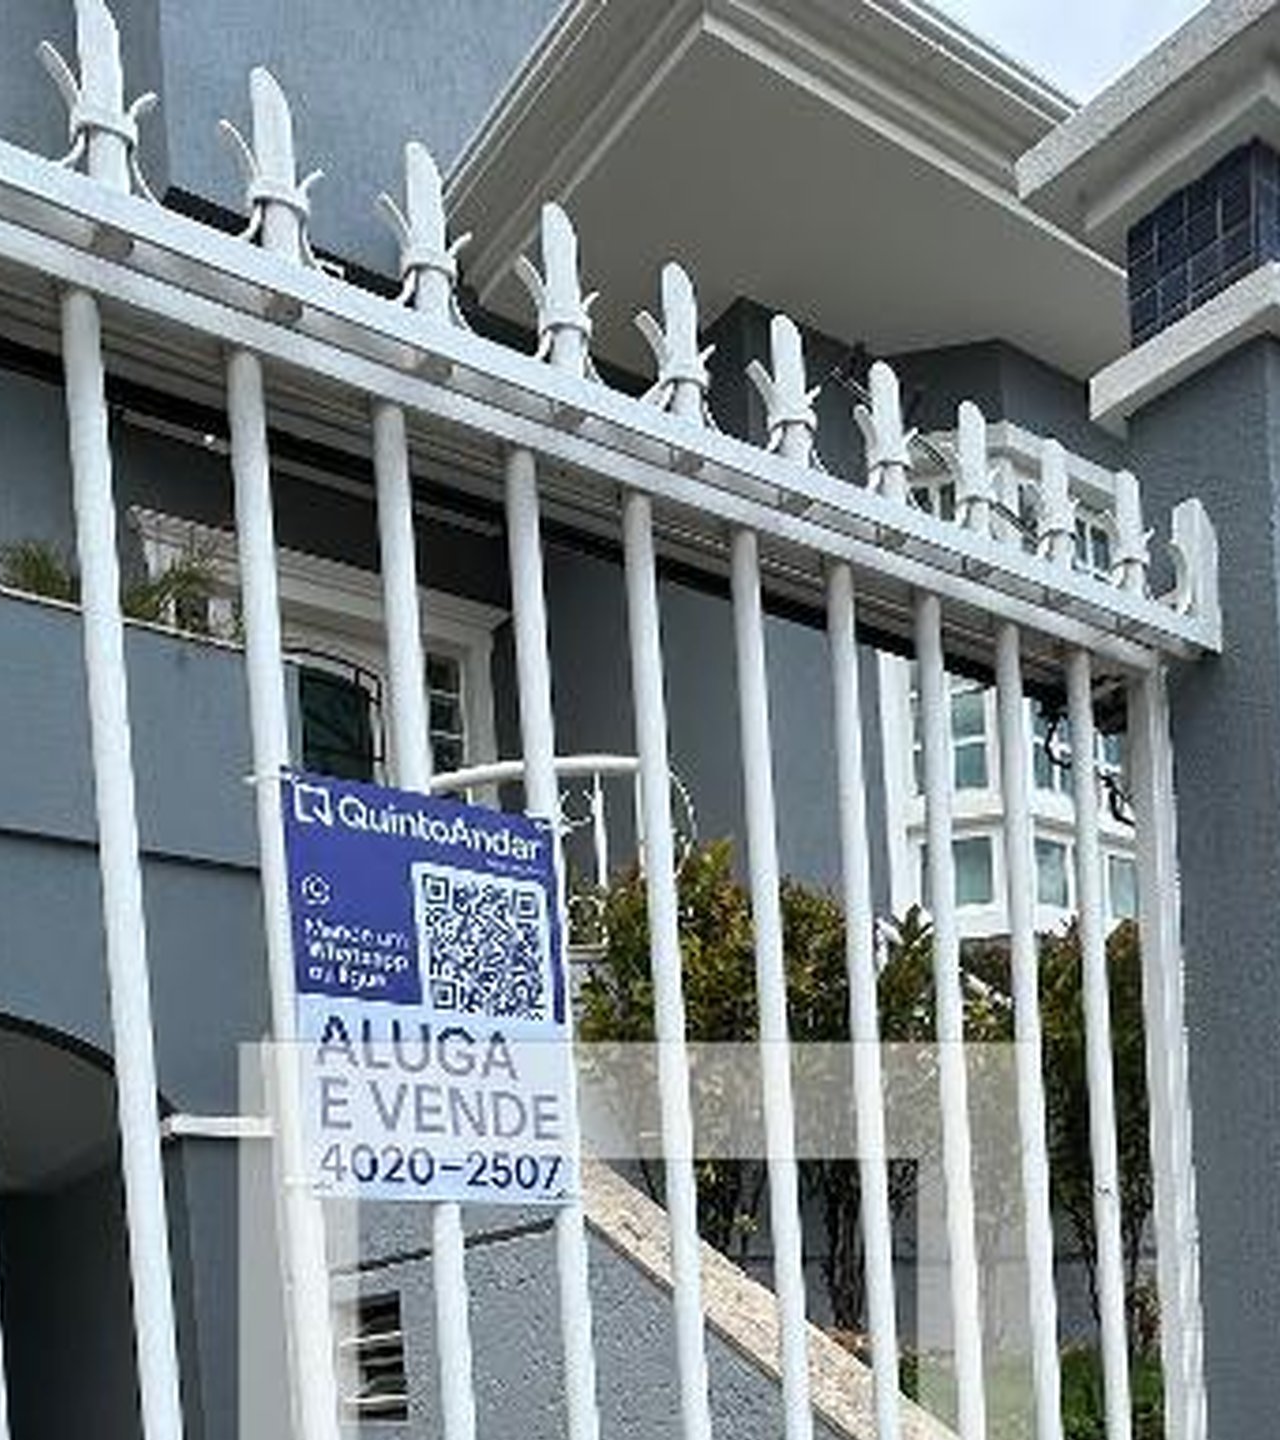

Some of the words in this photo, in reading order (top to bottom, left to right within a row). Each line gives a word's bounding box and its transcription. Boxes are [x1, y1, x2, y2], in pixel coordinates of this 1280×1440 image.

[338, 796, 542, 860] QuintoAndar
[317, 1015, 518, 1081] ALUGA
[319, 1076, 352, 1130] E
[368, 1079, 560, 1141] VENDE
[321, 1143, 562, 1190] 4020-2507
